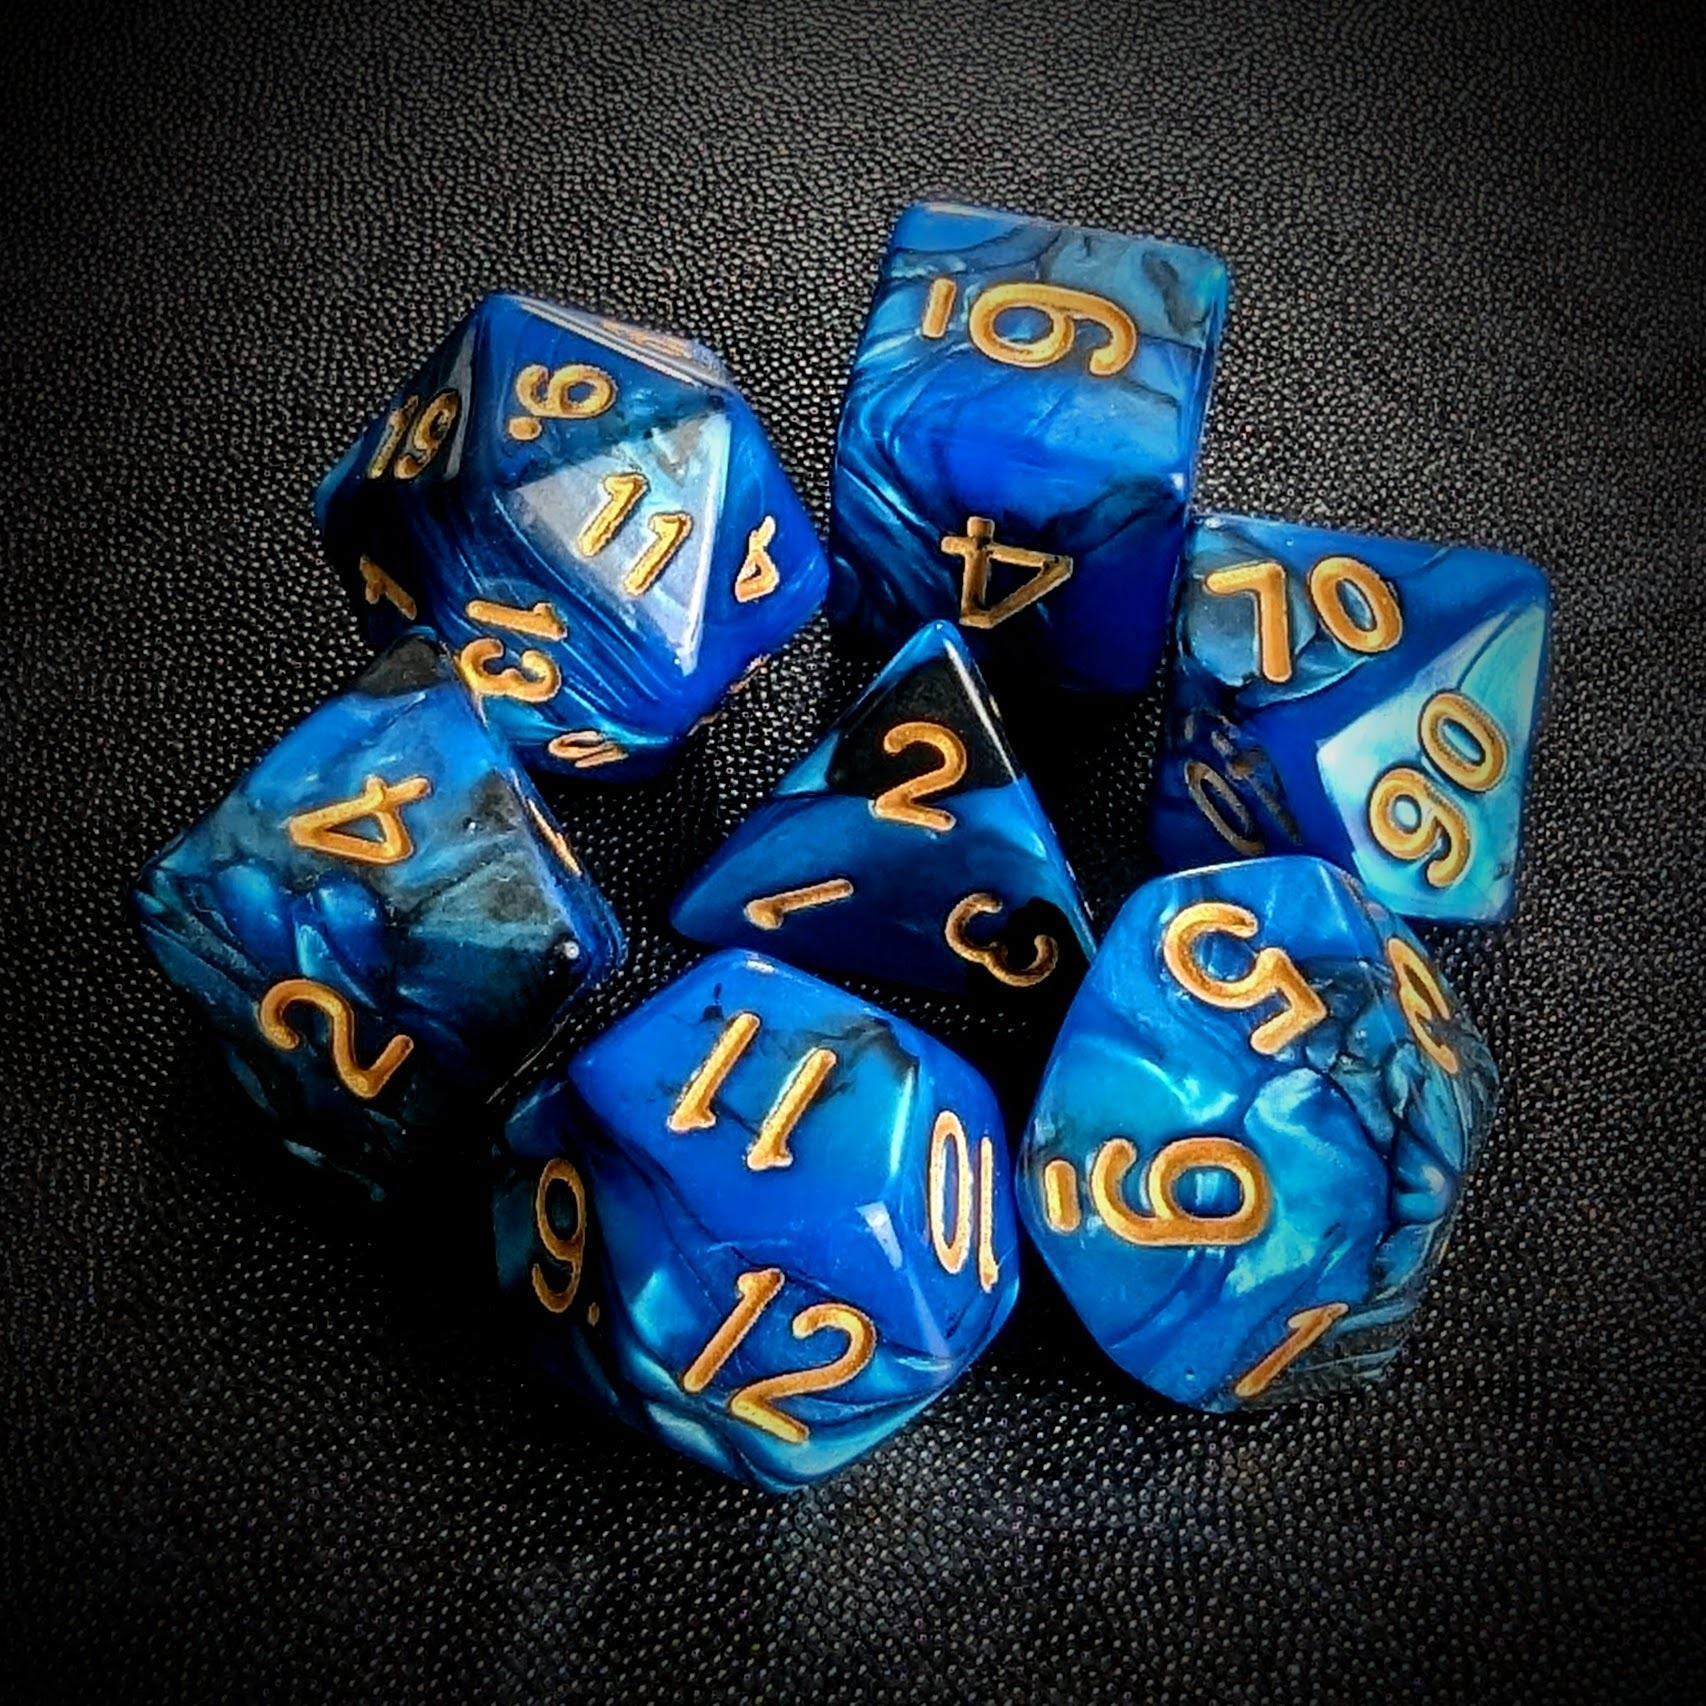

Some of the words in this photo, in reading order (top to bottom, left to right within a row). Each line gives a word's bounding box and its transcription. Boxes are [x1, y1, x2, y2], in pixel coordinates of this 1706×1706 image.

[922, 275, 1139, 378] 6
[576, 472, 692, 596] 11
[940, 515, 1075, 630] 4
[456, 599, 567, 704] 13
[1202, 556, 1403, 684] 70
[287, 774, 433, 865] 4
[868, 719, 968, 832] 2
[1368, 692, 1507, 886] 90
[743, 878, 855, 931] 1
[944, 892, 1060, 989] 3
[1163, 900, 1329, 1053] 5
[257, 977, 415, 1100] 2
[666, 1013, 837, 1171] 11
[927, 1110, 999, 1293] 10
[1042, 1136, 1271, 1246] 9
[680, 1268, 876, 1443] 12
[1234, 1302, 1349, 1399] 1
